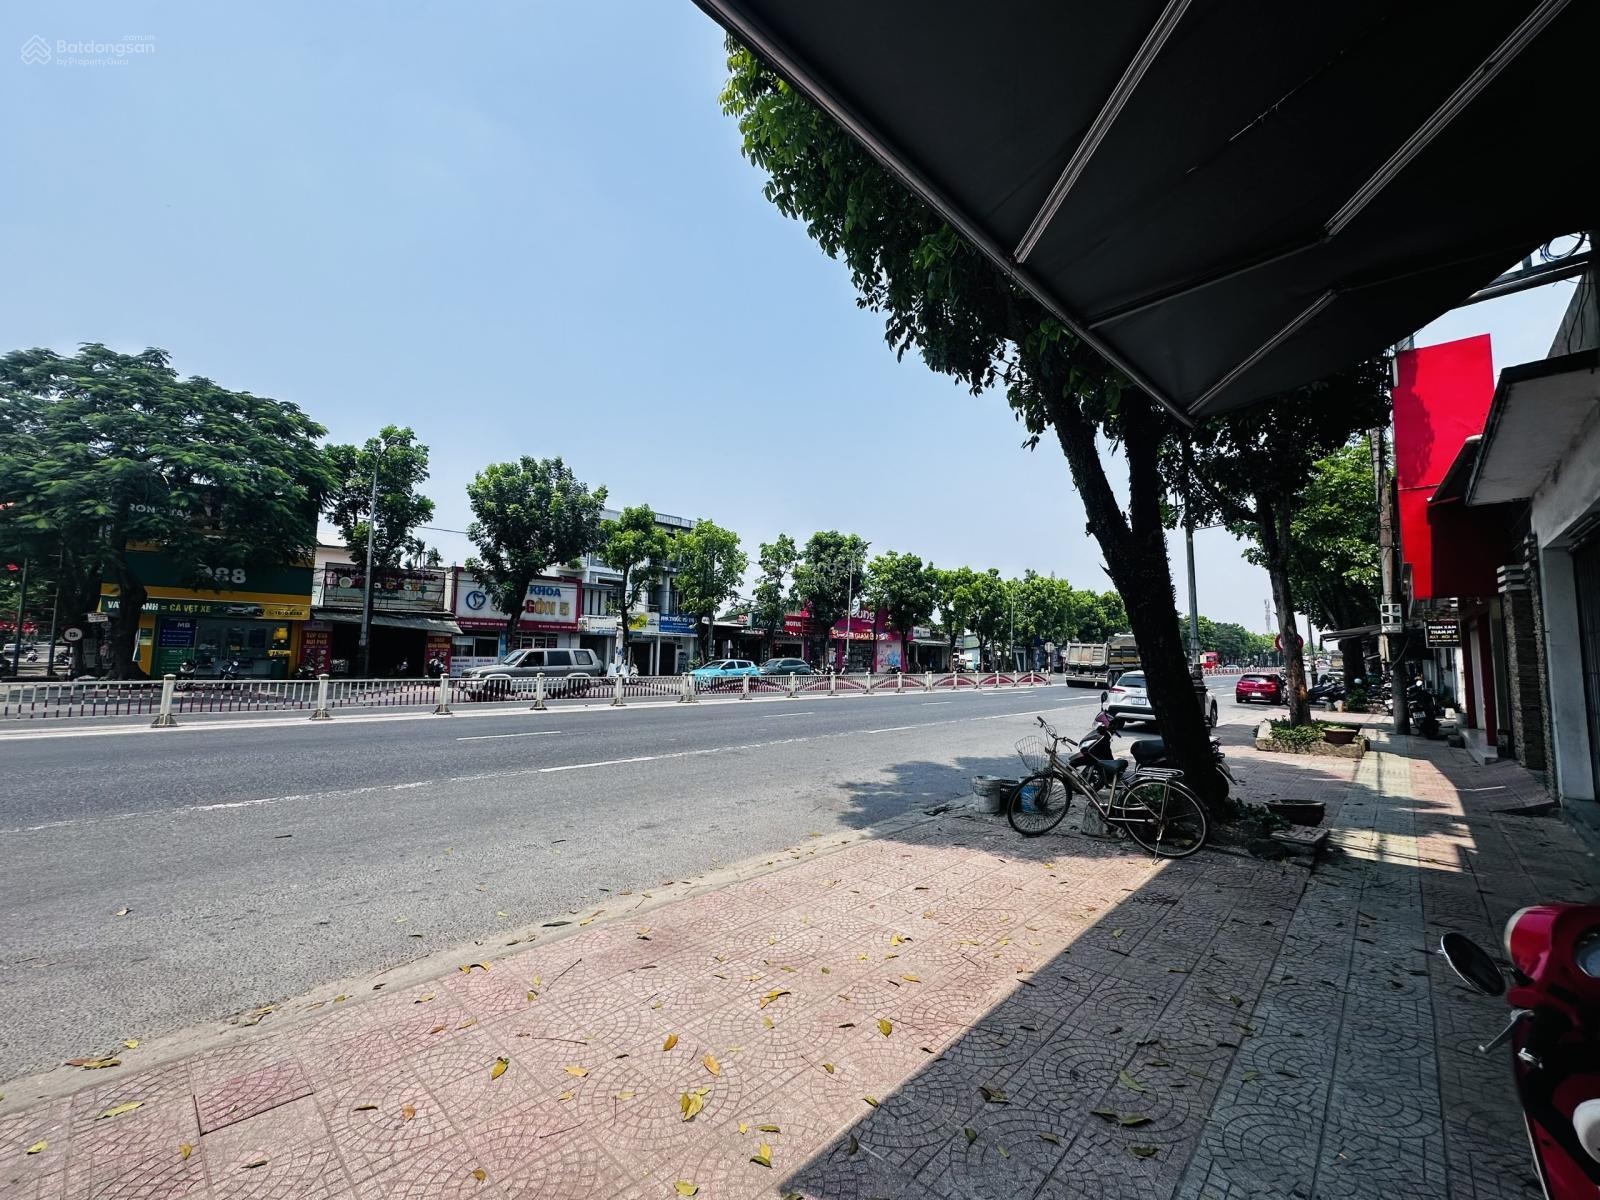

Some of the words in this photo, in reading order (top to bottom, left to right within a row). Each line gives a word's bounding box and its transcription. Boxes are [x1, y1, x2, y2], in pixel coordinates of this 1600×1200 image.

[529, 586, 562, 597] KHOA
[107, 601, 121, 609] VA
[559, 601, 569, 616] 5
